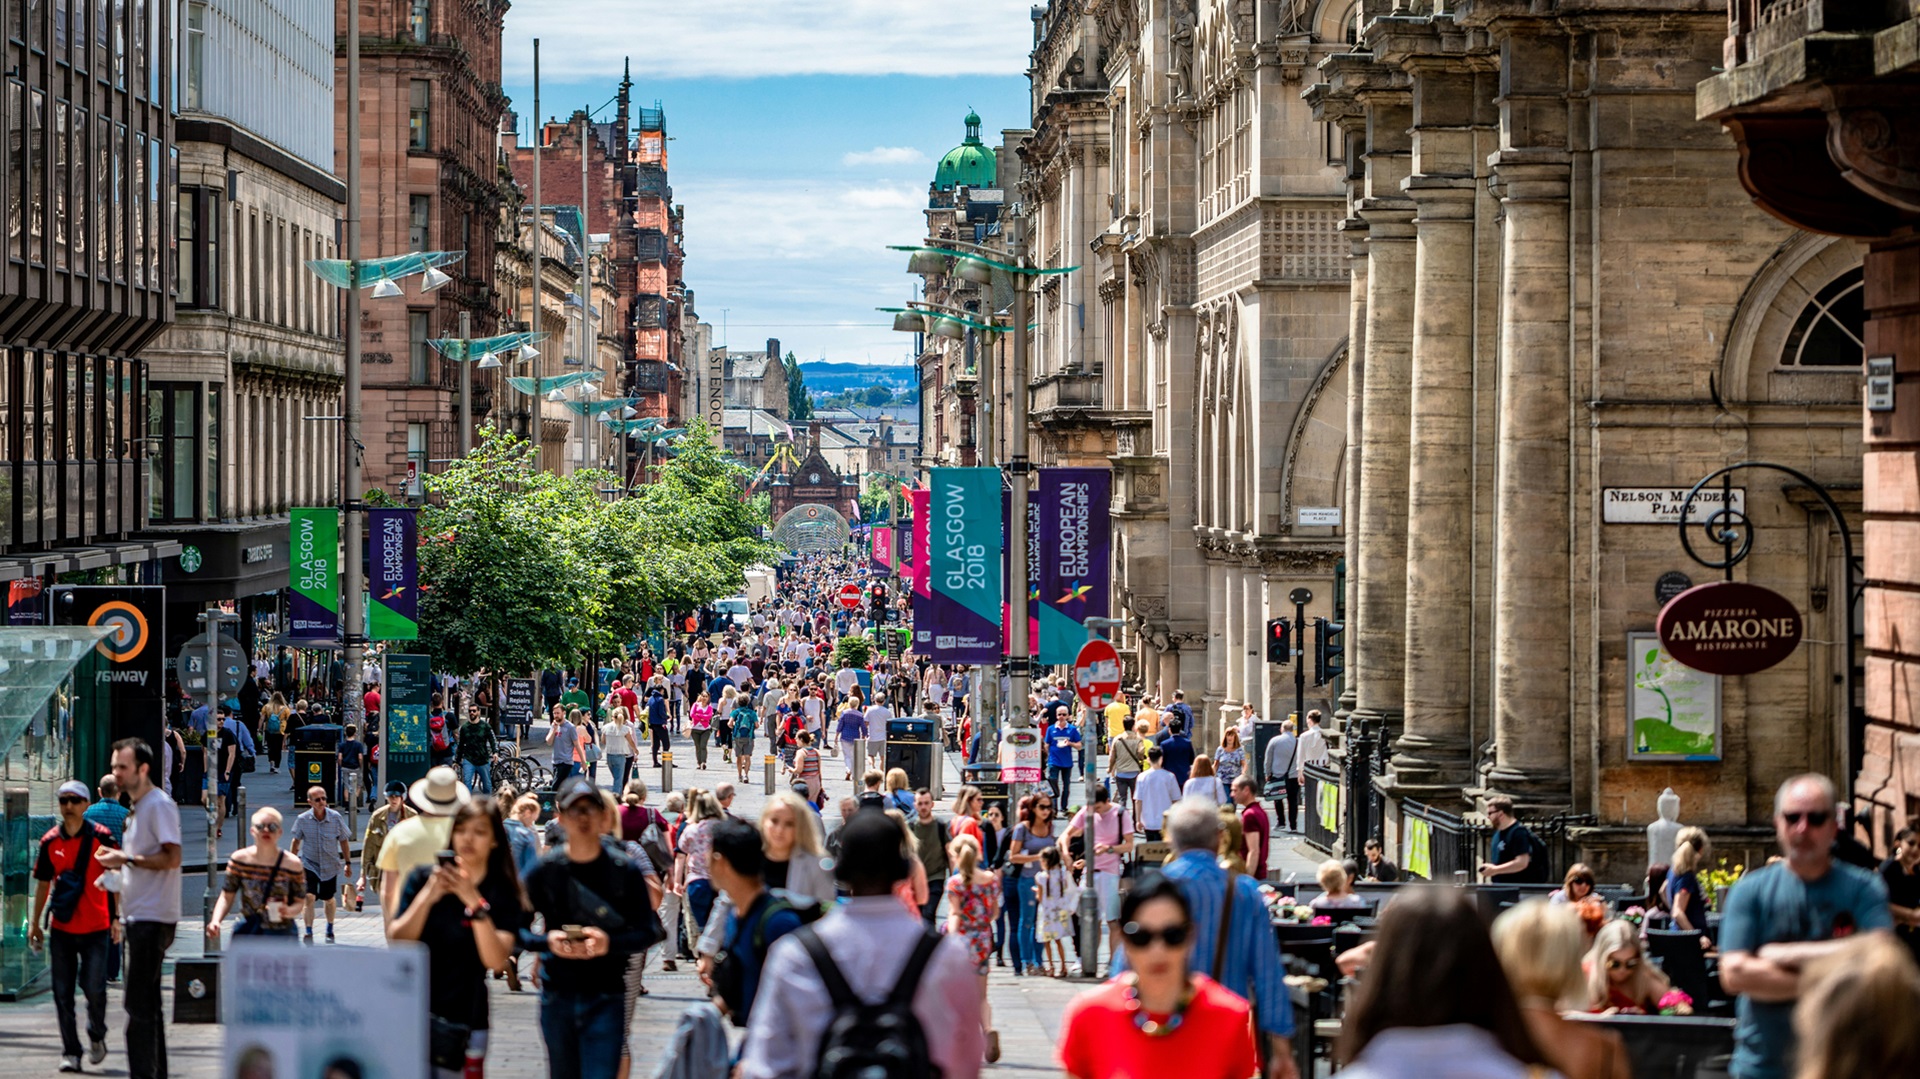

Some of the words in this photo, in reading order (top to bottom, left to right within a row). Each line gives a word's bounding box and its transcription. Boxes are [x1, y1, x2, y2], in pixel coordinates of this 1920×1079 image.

[711, 357, 721, 373] ST
[1610, 491, 1663, 502] NELSON
[946, 484, 965, 589] GLASGOW
[1060, 482, 1077, 577] EUROPEAN
[1077, 483, 1089, 577] CHAMPIONSHIPS
[300, 518, 314, 589] GLASGOW
[384, 517, 395, 581] EUROPEAN
[395, 517, 403, 581] CHAMPIONSHIPS
[967, 544, 985, 589] 2018
[314, 558, 327, 589] 2018
[1669, 618, 1794, 641] AMARONE
[1704, 608, 1757, 617] PIZZERIA
[937, 637, 955, 648] HM
[1695, 641, 1768, 651] RISTORANTE
